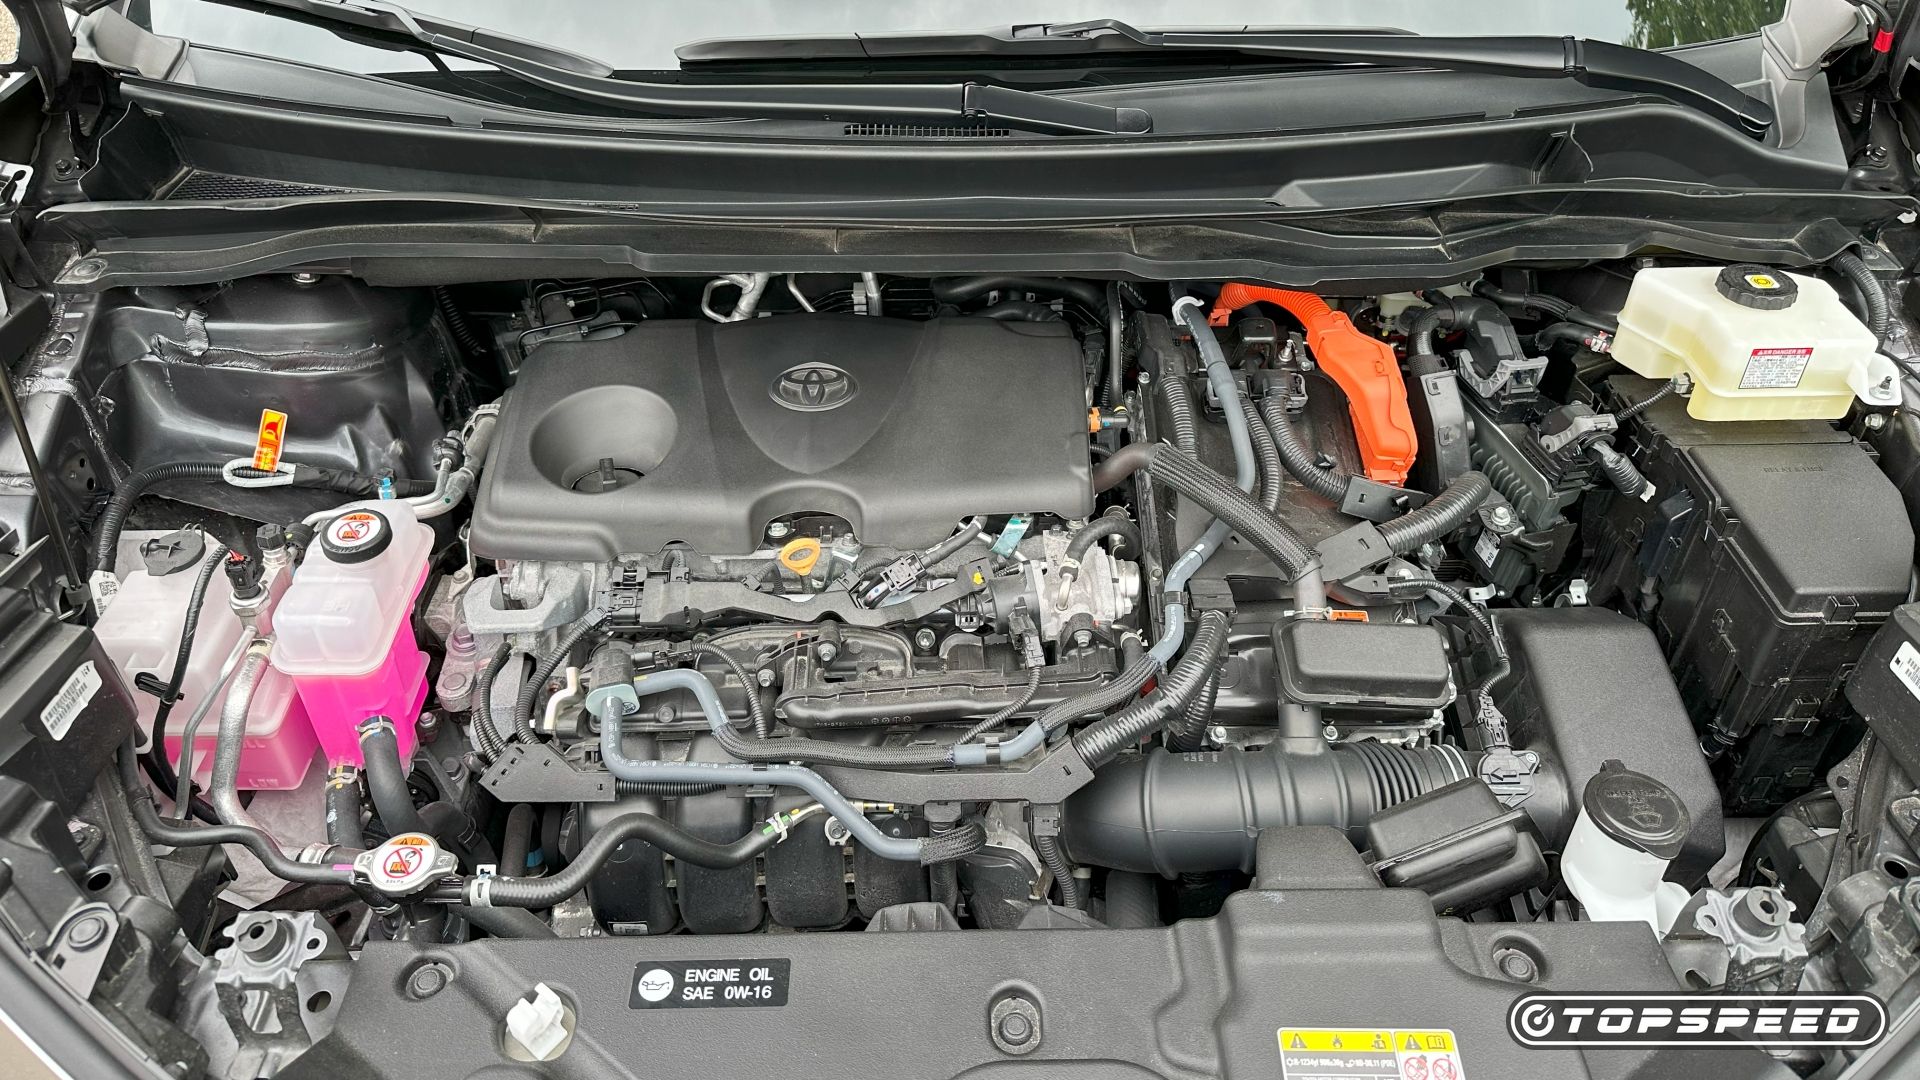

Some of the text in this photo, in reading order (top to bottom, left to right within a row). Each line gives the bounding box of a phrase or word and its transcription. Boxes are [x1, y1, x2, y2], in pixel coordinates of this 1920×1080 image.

[685, 967, 774, 982] ENGINE OIL
[682, 985, 772, 1000] SAE 0W-16
